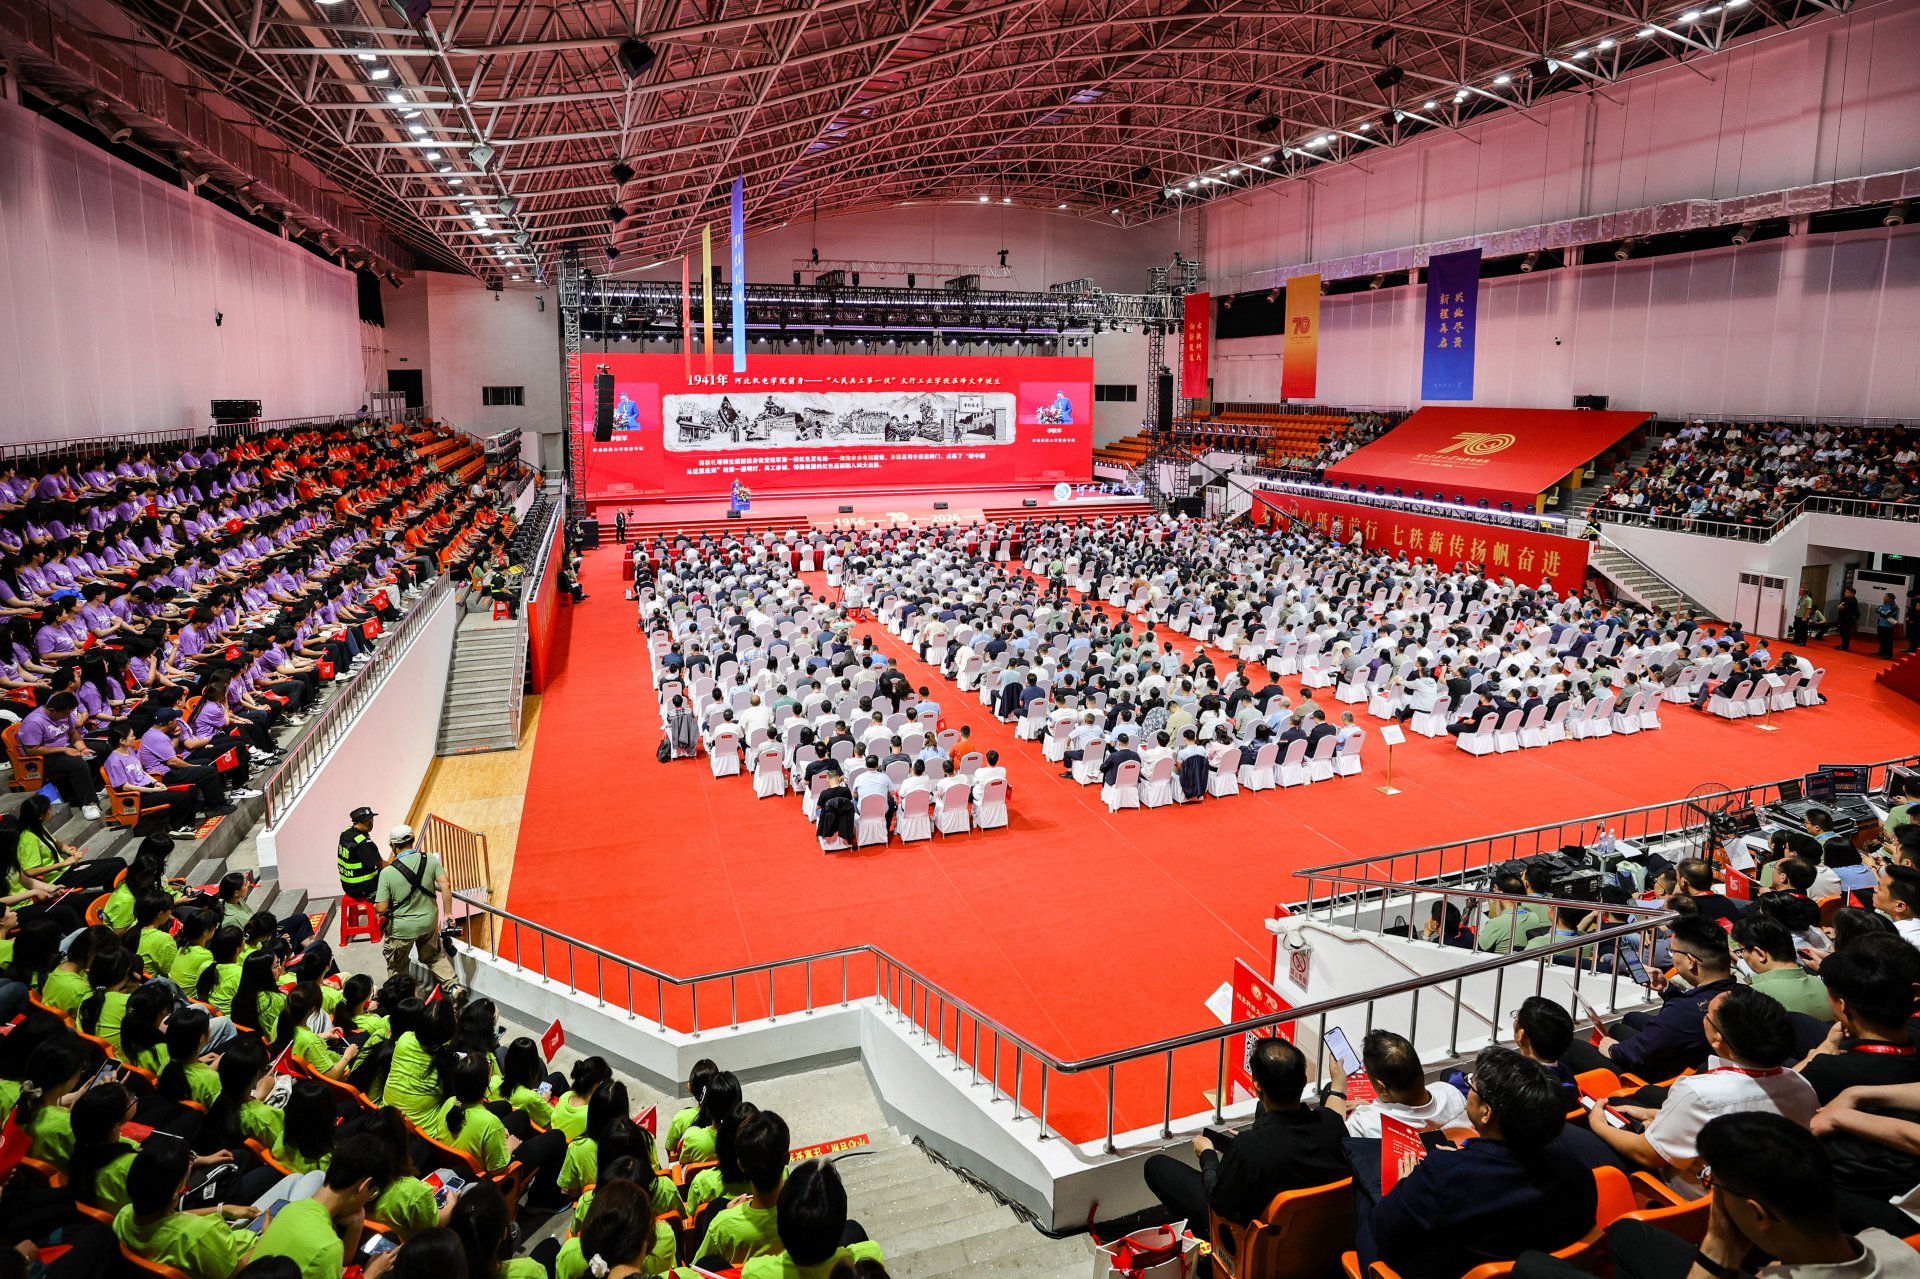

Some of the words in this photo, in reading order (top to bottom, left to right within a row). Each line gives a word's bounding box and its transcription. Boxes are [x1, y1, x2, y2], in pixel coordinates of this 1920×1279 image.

[1292, 316, 1311, 335] 70
[687, 373, 729, 387] 1941年
[1435, 431, 1517, 456] 70
[834, 516, 866, 527] 1956
[930, 513, 961, 523] 2026
[1391, 524, 1562, 578] 七秩薪传扬帆奋进
